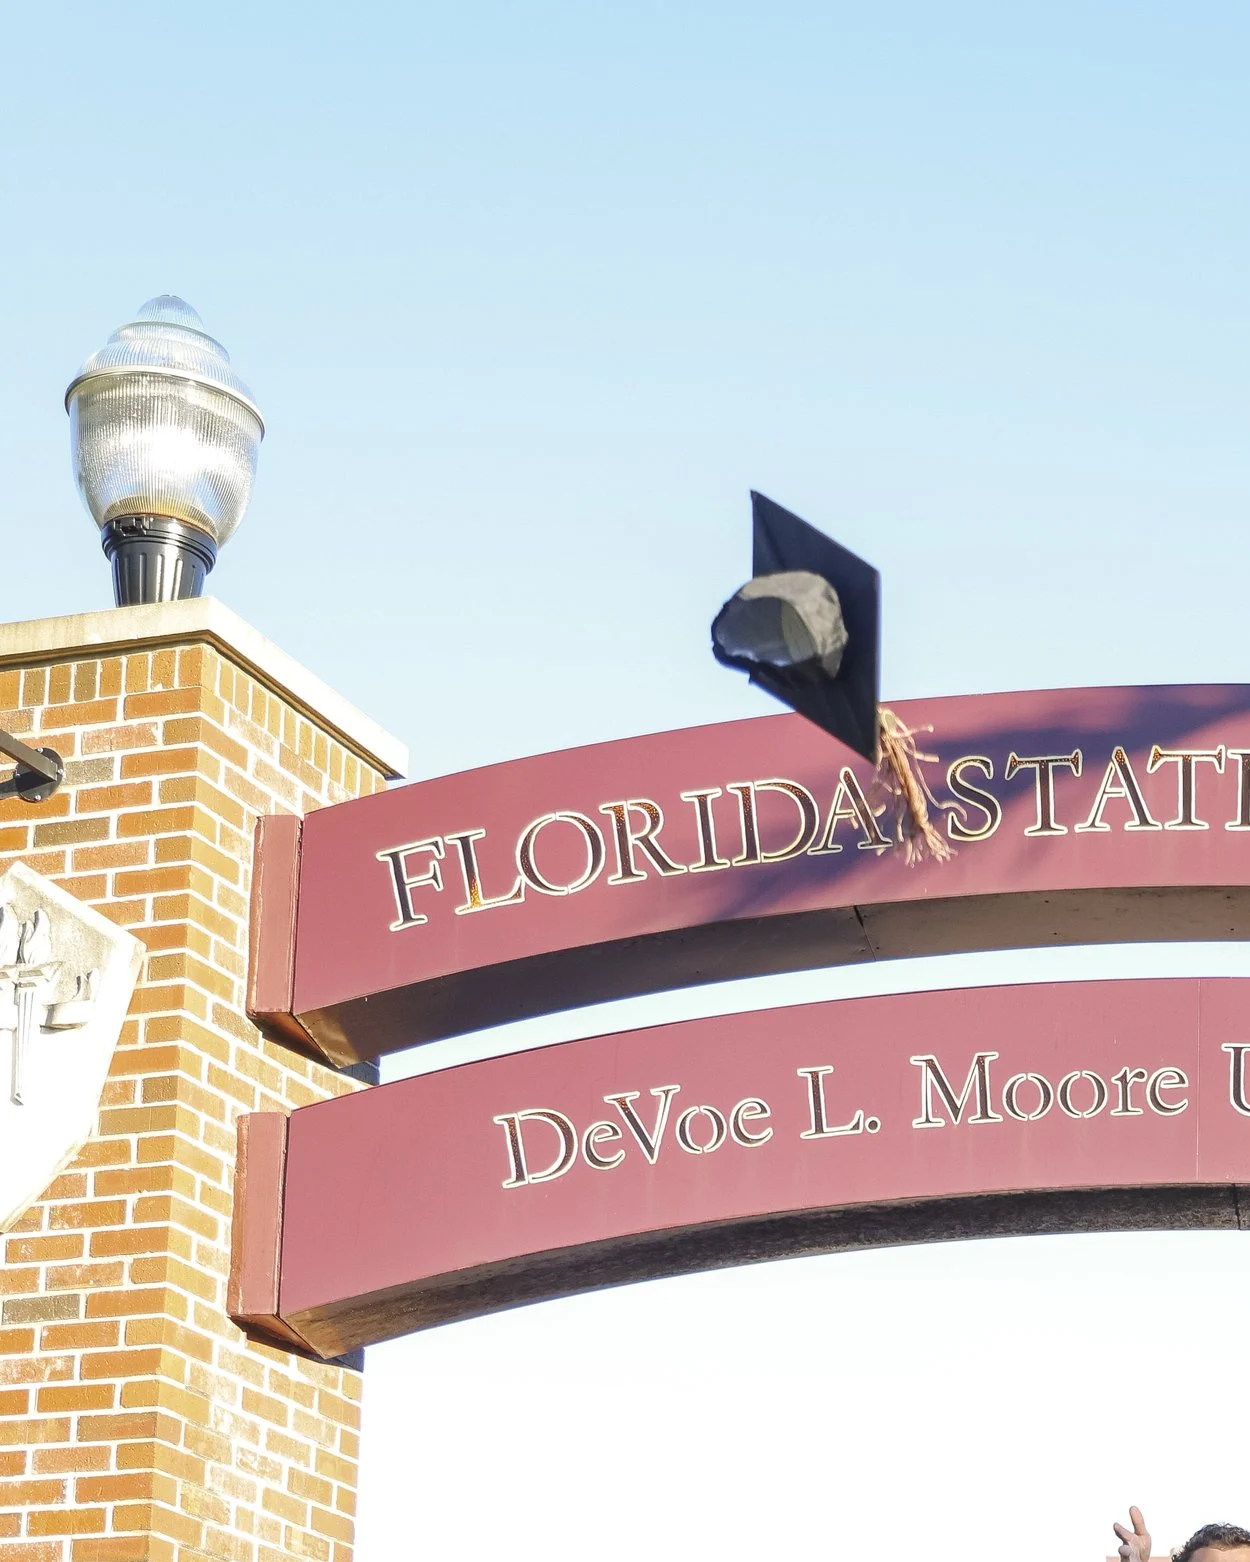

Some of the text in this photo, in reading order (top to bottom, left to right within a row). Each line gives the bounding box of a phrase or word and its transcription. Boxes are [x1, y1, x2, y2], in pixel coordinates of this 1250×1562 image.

[376, 767, 893, 933] FLORIDA
[493, 1084, 773, 1189] DeVoe
[797, 1065, 881, 1139] L.
[910, 1051, 1189, 1129] Moore
